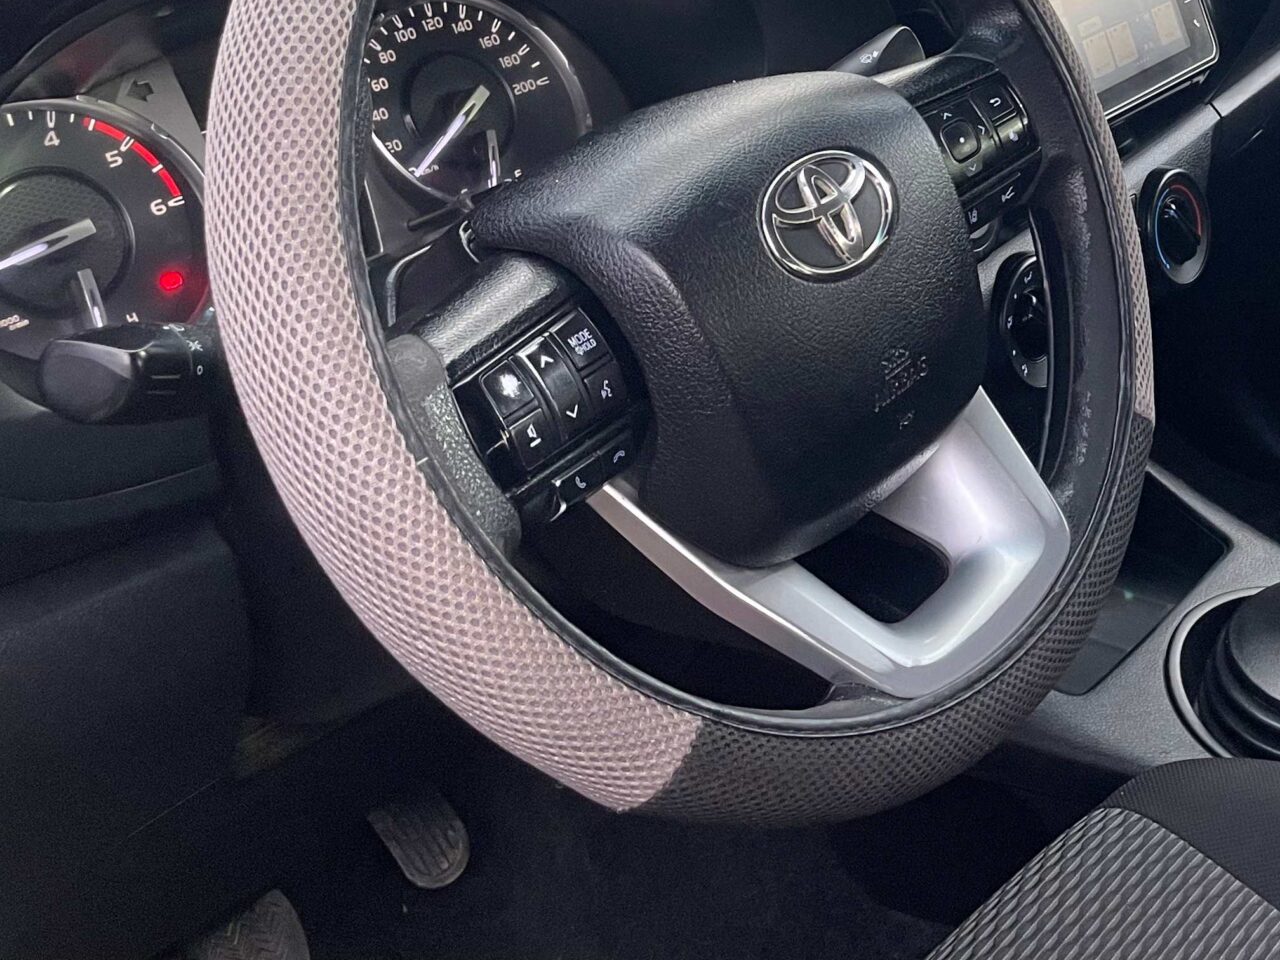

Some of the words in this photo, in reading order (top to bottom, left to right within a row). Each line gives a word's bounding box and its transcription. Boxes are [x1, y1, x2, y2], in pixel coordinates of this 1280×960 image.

[422, 16, 444, 32] 120
[452, 19, 473, 34] 140
[394, 27, 417, 43] 100
[479, 34, 501, 49] 160
[379, 49, 396, 64] 80
[499, 53, 520, 68] 180
[371, 77, 389, 92] 60
[512, 79, 536, 95] 200
[372, 107, 389, 121] 40
[44, 130, 61, 146] 4
[105, 150, 123, 168] 5
[150, 198, 167, 216] 6
[567, 328, 593, 348] MODE
